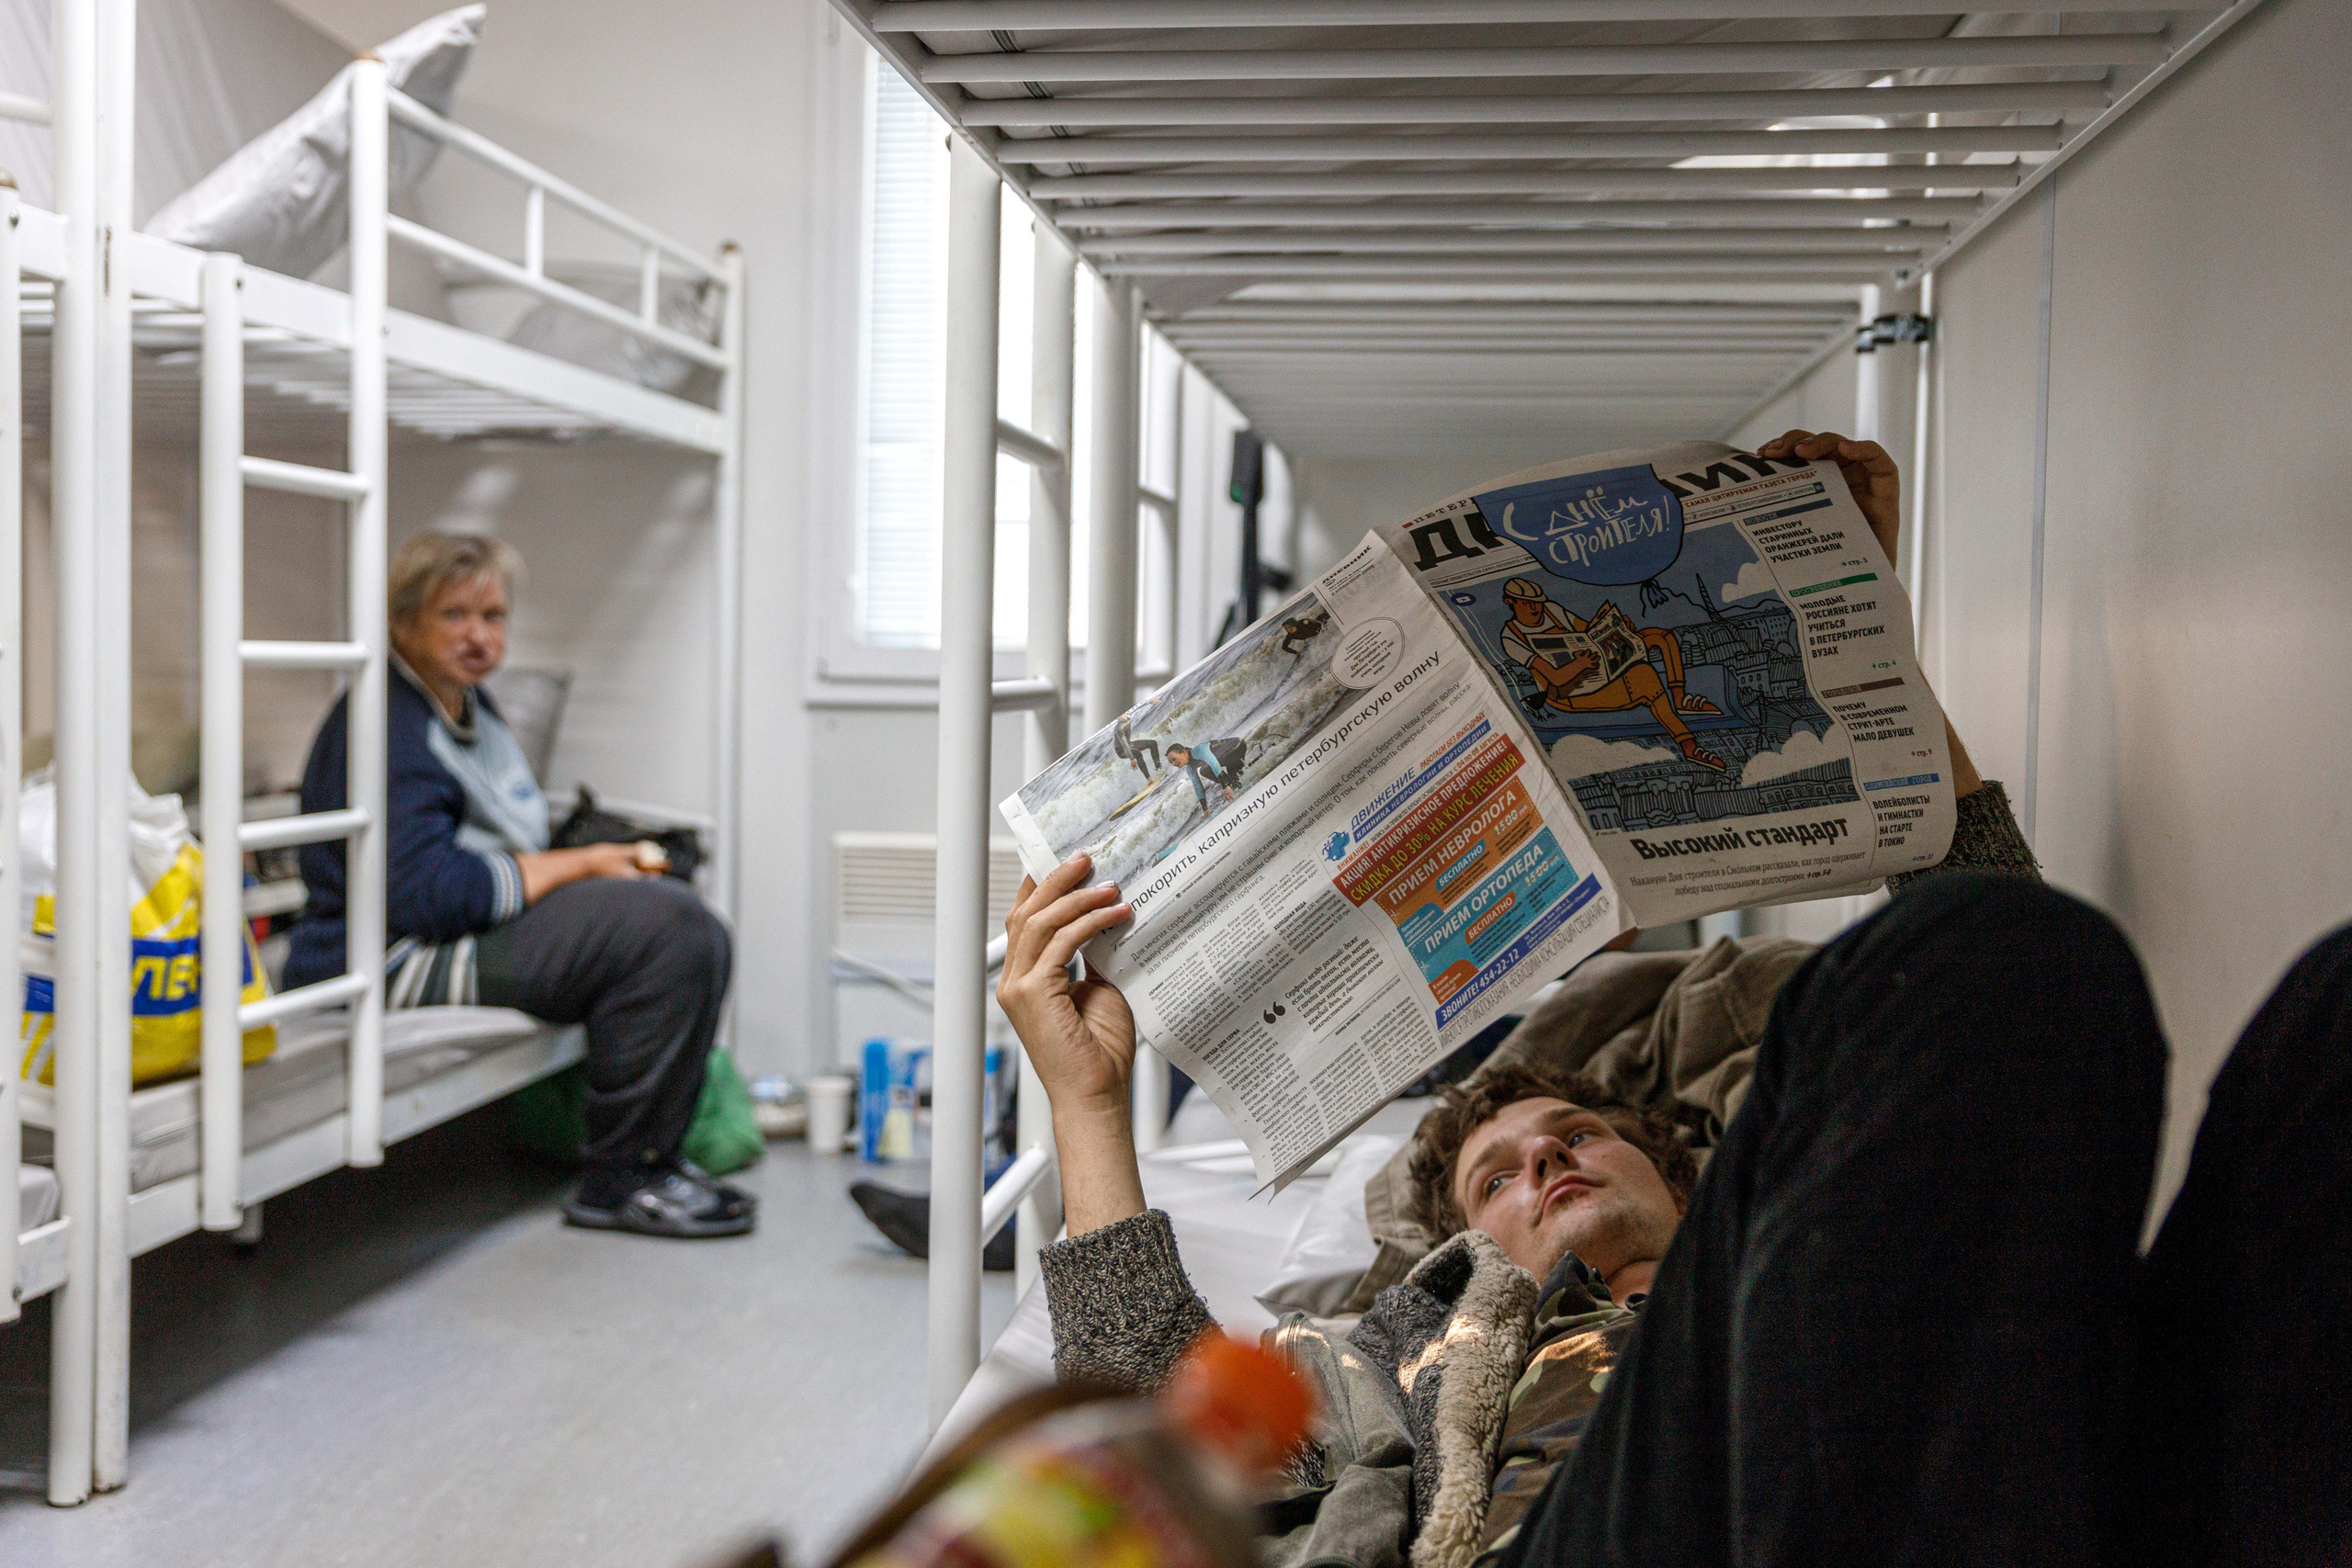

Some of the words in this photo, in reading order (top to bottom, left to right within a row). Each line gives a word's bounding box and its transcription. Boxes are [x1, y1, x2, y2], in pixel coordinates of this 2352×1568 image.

[1685, 496, 1710, 509] САМАЯ
[1711, 484, 1758, 502] ЦИТИРУЕМАЯ
[1758, 477, 1786, 490] ГАЗЕТА
[1745, 512, 1778, 525] НОВОСТИ
[1752, 519, 1803, 536] ИНВЕСТОРУ
[1758, 526, 1813, 545] СТАРИННЫХ
[1765, 536, 1819, 553] ОРАНЖЕРЕЙ
[1819, 530, 1844, 542] ДАЛИ
[1770, 548, 1811, 563] УЧАСТКИ
[1811, 542, 1842, 554] ЗЕМЛИ
[1799, 594, 1846, 609] МОЛОДЫЕ
[1805, 605, 1849, 620] РОССИЯНЕ
[1849, 601, 1876, 613] ХОТЯТ
[1807, 618, 1846, 632] УЧИТЬСЯ
[1809, 637, 1815, 645] В
[1816, 625, 1884, 644] ПЕТЕРБУРГСКИХ
[1811, 645, 1838, 658] ВУЗАХ
[1833, 701, 1866, 712] ПОЧЕМУ
[1847, 704, 1907, 719] СОВРЕМЕННОМ
[1847, 716, 1894, 730] СТРИТ-АРТЕ
[1419, 743, 1447, 769] РАБОТАЕМ
[1445, 736, 1457, 747] БЕЗ
[1853, 731, 1876, 742] МАЛО
[1877, 726, 1914, 739] ДЕВУШЕК
[1131, 853, 1197, 909] покорить
[1199, 785, 1279, 853] капризную
[1282, 693, 1392, 785] петербургскую
[1394, 650, 1442, 694] волну
[1354, 807, 1390, 839] КЛИНИКА
[1390, 768, 1437, 808] НЕВРОЛОГИИ
[1443, 725, 1487, 762] ОРТОПЕДИИ
[1337, 840, 1369, 870] ВНИМАНИЕ!
[1455, 759, 1465, 768] 04
[1470, 747, 1480, 756] 08
[1478, 732, 1498, 750] АВГУСТА
[1340, 856, 1373, 887] АКЦИЯ!
[1371, 797, 1441, 860] АНТИКРИЗИСНОЕ
[1442, 740, 1506, 799] ПРЕДЛОЖЕНИЕ!
[1348, 768, 1416, 829] ДВИЖЕНИЕ
[1872, 795, 1930, 809] ВОЛЕЙБОЛИСТЫ
[1883, 807, 1924, 821] ГИМНАСТКИ
[1130, 945, 1146, 961] Для
[1144, 928, 1167, 949] многих
[1167, 907, 1193, 931] серфинг
[1193, 869, 1238, 908] ассоциируется
[1241, 832, 1280, 867] гавайскими
[1279, 809, 1307, 835] пляжами
[1342, 756, 1372, 782] Серферы
[1376, 730, 1402, 753] берегов
[1402, 715, 1419, 732] Невы
[1419, 699, 1440, 716] ловят
[1439, 681, 1461, 702] волну
[1351, 862, 1392, 901] СКИДКА
[1390, 849, 1408, 867] ДО
[1406, 829, 1430, 853] 30%
[1428, 816, 1446, 834] НА
[1443, 793, 1472, 820] КУРС
[1470, 753, 1519, 798] ЛЕЧЕНИЯ
[1630, 829, 1746, 861] Высокий
[1745, 818, 1848, 847] стандарт
[1878, 826, 1888, 835] НА
[1888, 822, 1913, 833] СТАРТЕ
[1144, 933, 1178, 963] минусовую
[1216, 890, 1228, 902] им
[1227, 884, 1238, 895] не
[1236, 861, 1264, 886] страшны
[1262, 848, 1280, 864] снег
[1283, 818, 1315, 845] холодный
[1353, 773, 1367, 786] как
[1366, 749, 1396, 775] покорить
[1396, 723, 1427, 750] северные
[1387, 858, 1438, 904] ПРИЕМ
[1437, 791, 1515, 862] НЕВРОЛОГА
[1883, 836, 1905, 847] ТОКИО
[1438, 845, 1483, 886] БЕСПЛАТНО
[1422, 906, 1471, 952] ПРИЕМ
[1470, 845, 1543, 910] ОРТОПЕДА
[1145, 960, 1162, 976] зали
[1161, 939, 1187, 962] пионеры
[1187, 900, 1234, 940] петербургского
[1234, 874, 1264, 901] серфинга.
[1467, 897, 1513, 938] БЕСПЛАТНО
[1284, 978, 1307, 998] Серфинг
[1306, 964, 1323, 980] везде
[1342, 935, 1359, 950] даже
[1290, 992, 1304, 1005] если
[1303, 978, 1321, 995] брать
[1337, 953, 1351, 966] есть
[1351, 938, 1369, 955] места
[1440, 984, 1480, 1021] ЗВОНИТЕ!
[1477, 948, 1521, 987] 454-22-12
[1301, 992, 1317, 1009] почти
[1318, 966, 1350, 994] идеальными
[1303, 998, 1326, 1018] которые
[1327, 981, 1345, 999] хороши
[1346, 953, 1379, 982] практически
[1308, 1007, 1328, 1024] каждый
[1346, 974, 1367, 993] бывают
[1366, 959, 1384, 976] волны
